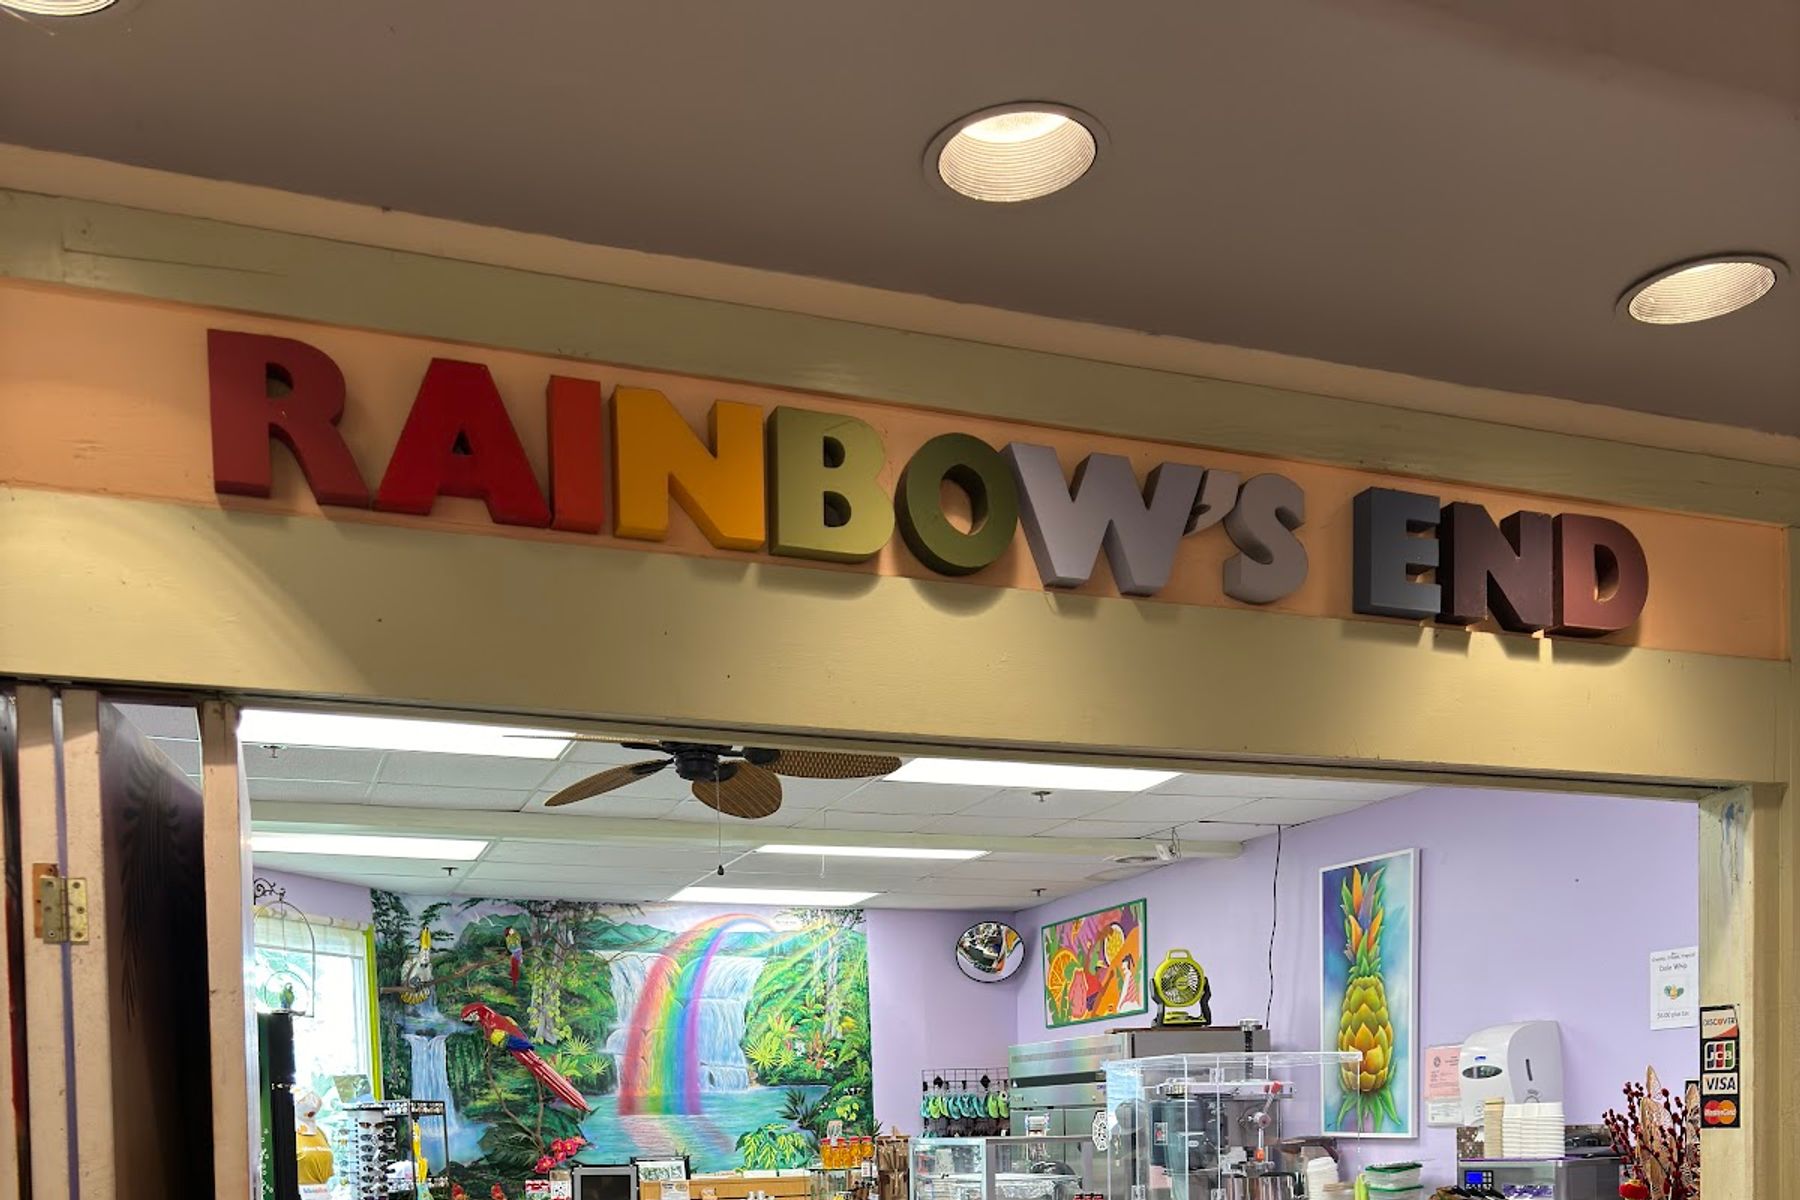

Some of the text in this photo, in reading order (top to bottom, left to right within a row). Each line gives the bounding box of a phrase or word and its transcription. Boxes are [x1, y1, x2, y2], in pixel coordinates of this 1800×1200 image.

[207, 328, 1648, 637] RAINBOW'S END
[1705, 1077, 1736, 1091] VISA
